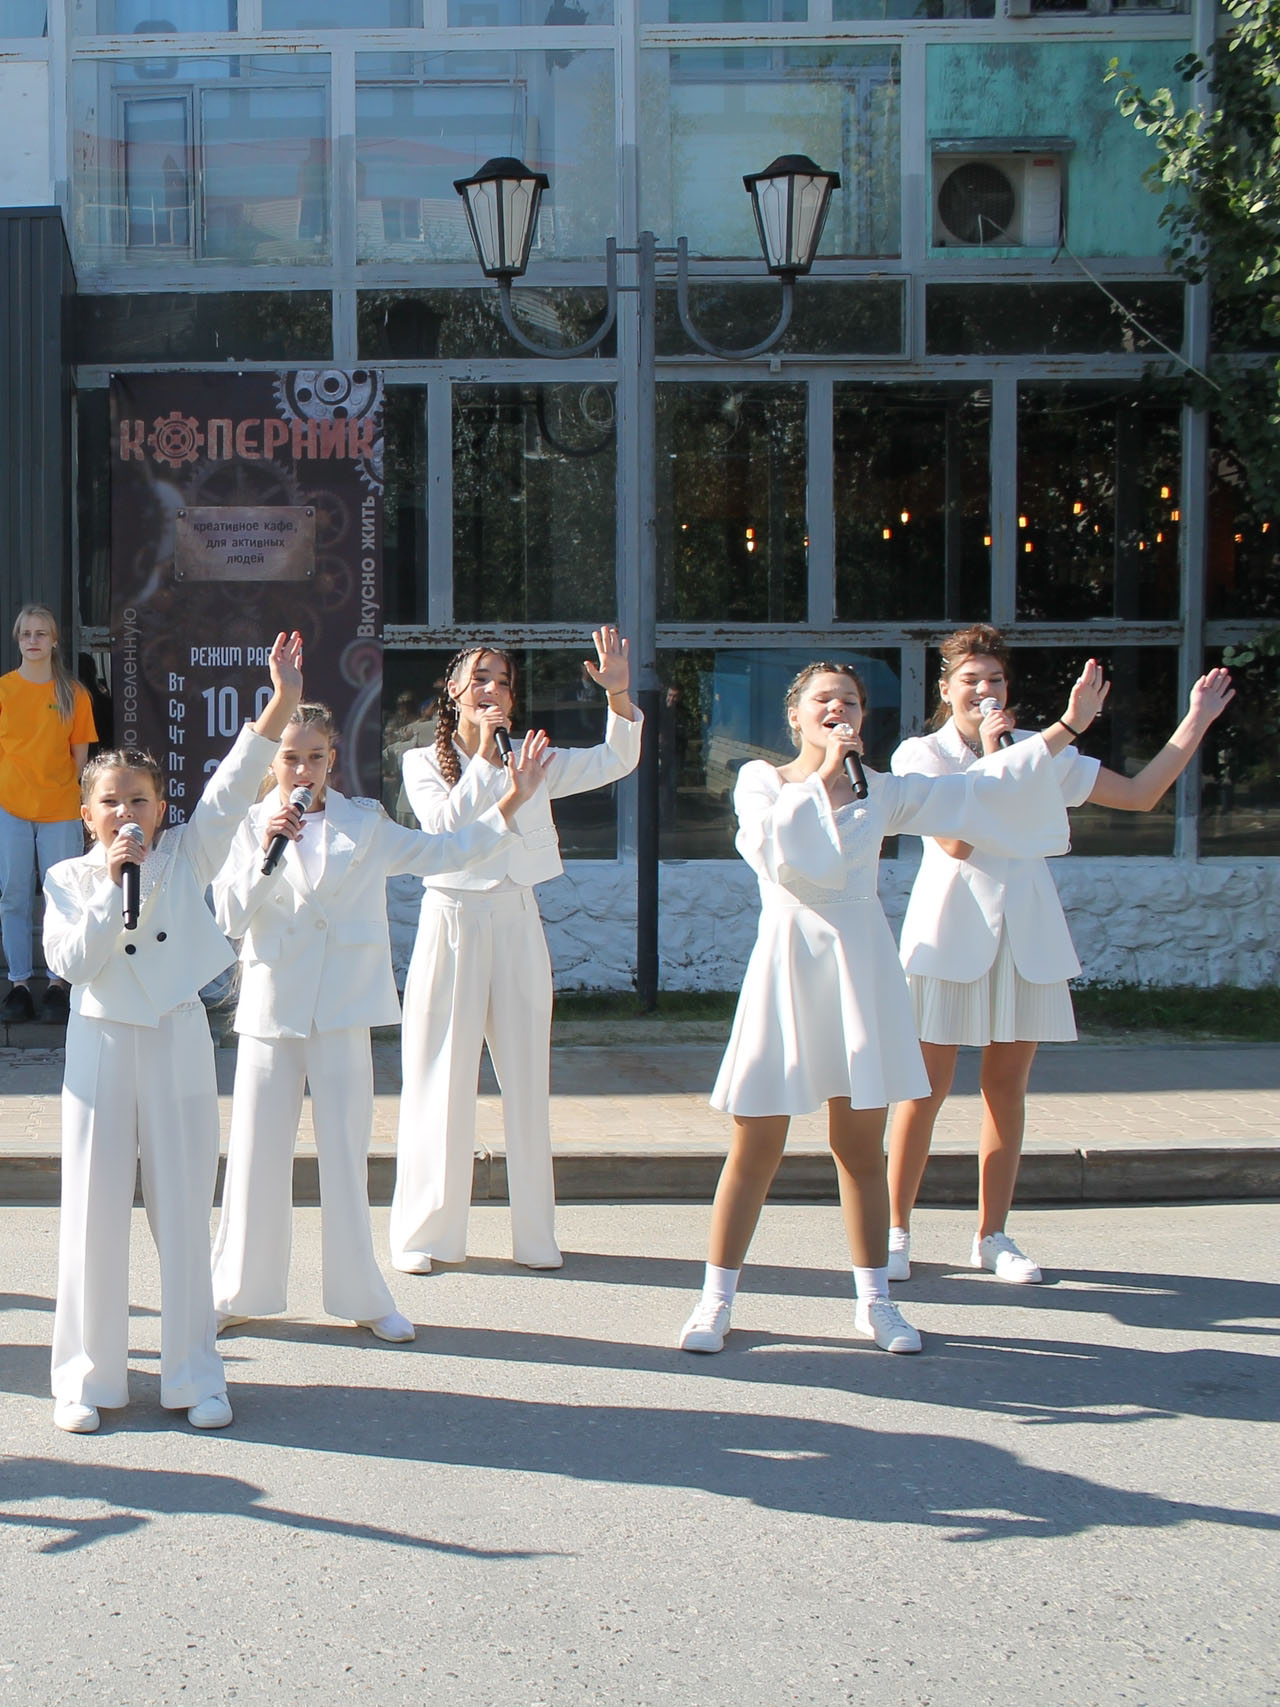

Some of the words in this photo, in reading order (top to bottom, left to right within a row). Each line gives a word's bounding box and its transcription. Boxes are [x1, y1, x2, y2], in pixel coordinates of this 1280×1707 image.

[193, 522, 259, 532] креативное
[264, 520, 298, 533] кафе,
[361, 496, 376, 550] жить
[206, 540, 227, 549] для
[231, 539, 285, 548] активных
[226, 552, 265, 565] людей
[356, 557, 380, 638] Вкусно
[123, 607, 142, 722] вселенную
[190, 647, 242, 666] РЕЖИМ
[169, 672, 185, 692] Вт
[169, 699, 185, 722] Ср
[169, 725, 185, 745] Чт
[169, 752, 185, 771] Пт
[169, 778, 185, 797] Сб
[169, 805, 185, 824] Вс
